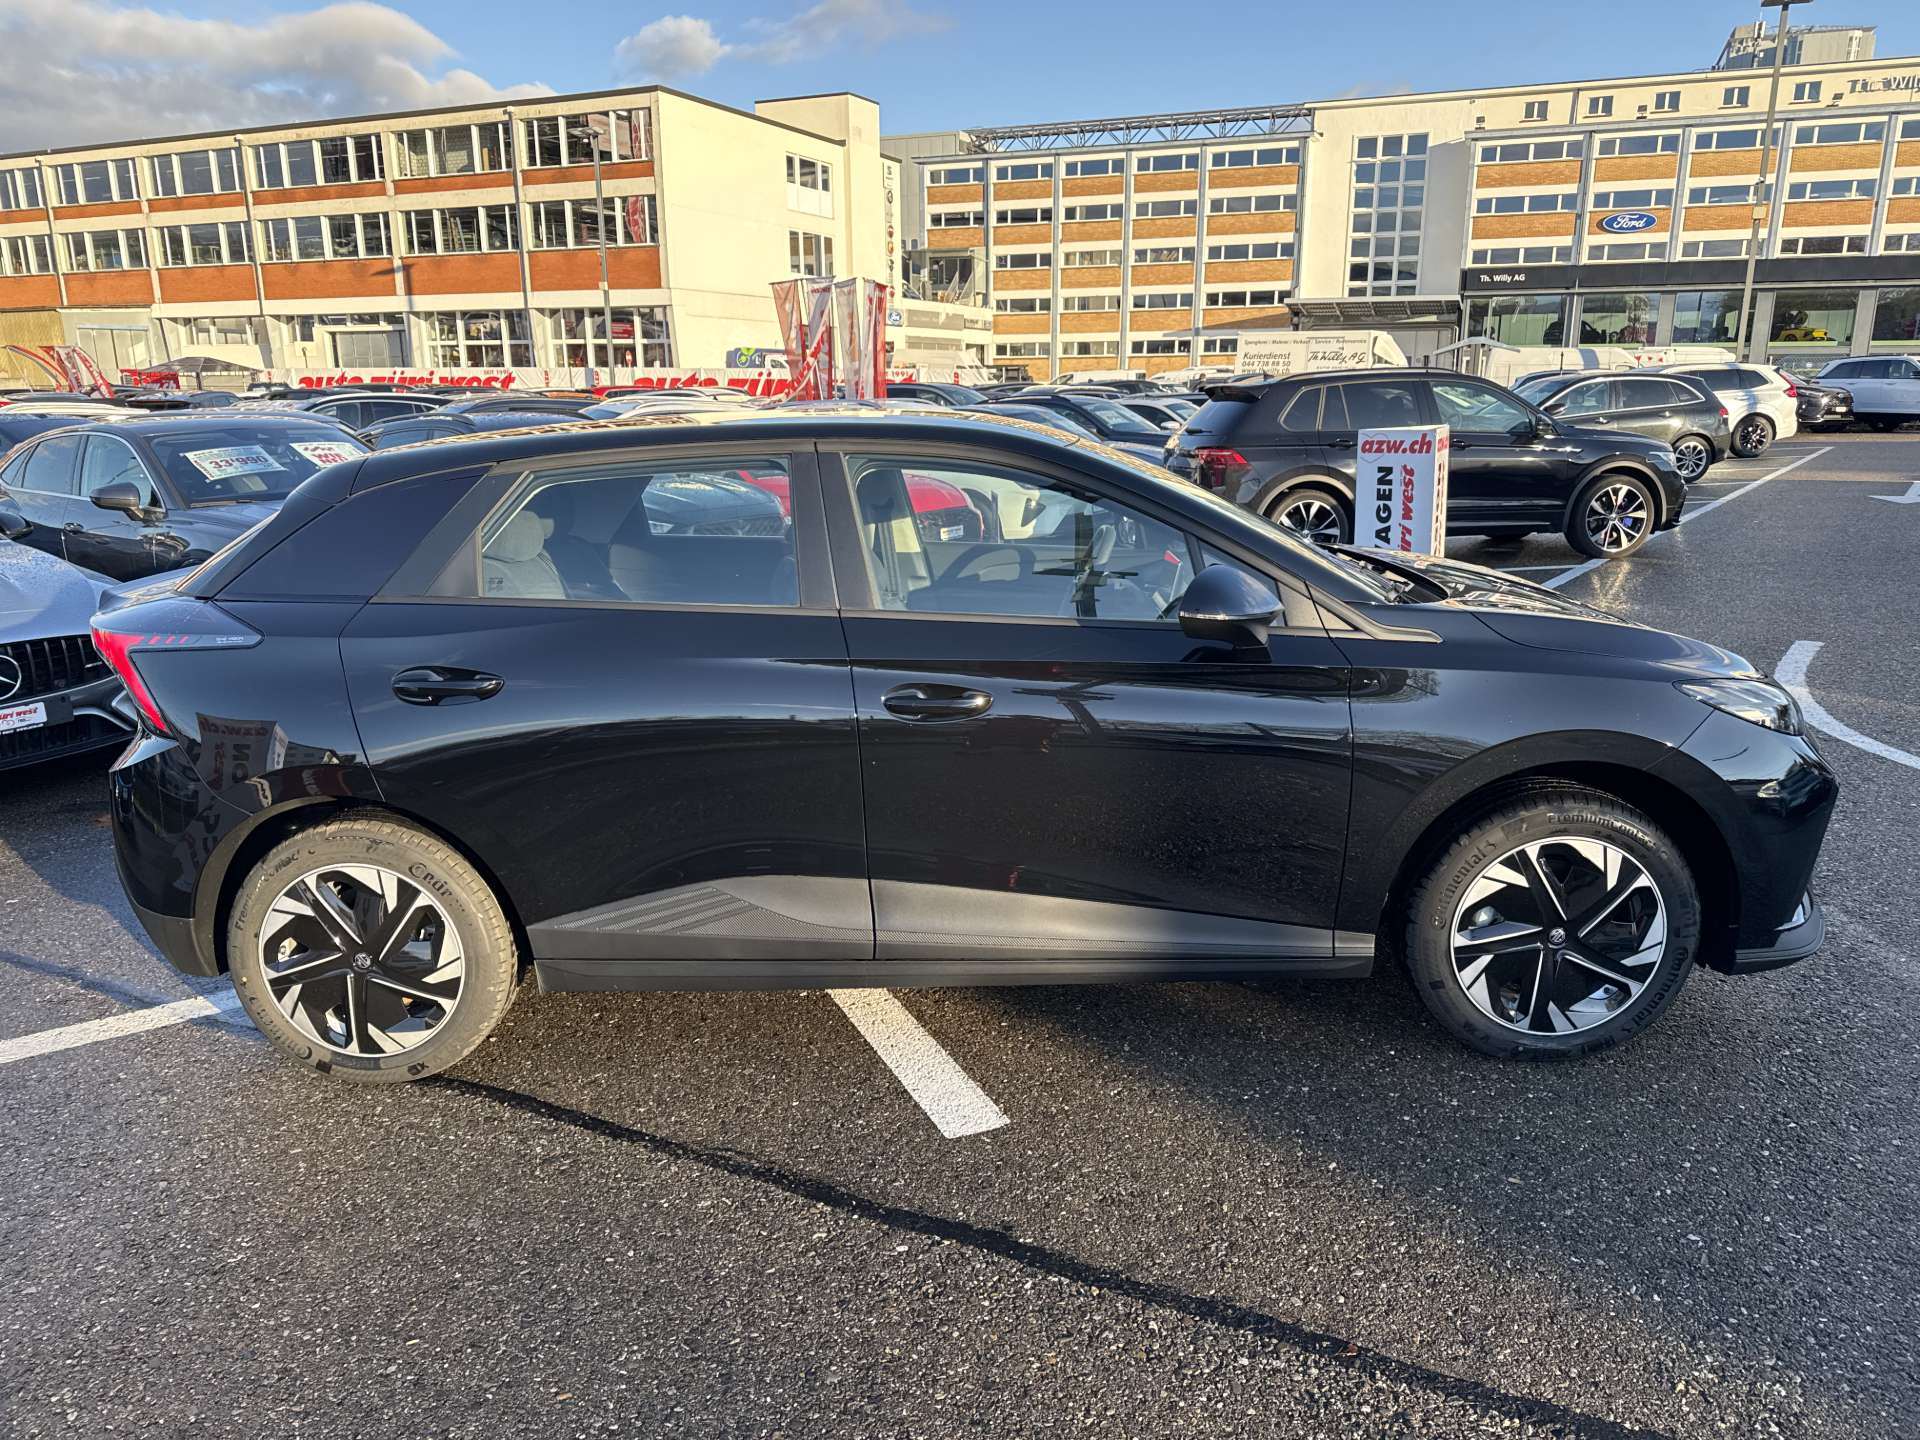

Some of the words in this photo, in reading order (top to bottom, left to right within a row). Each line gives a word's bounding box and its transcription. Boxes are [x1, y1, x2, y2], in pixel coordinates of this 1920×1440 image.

[1612, 214, 1647, 229] Ford
[1493, 274, 1512, 284] Willy
[1514, 273, 1526, 281] AG
[1242, 352, 1291, 360] Kurierdienst
[1320, 350, 1347, 364] Willy
[1349, 351, 1367, 364] AG
[299, 371, 364, 388] auto
[1361, 432, 1433, 454] azw.ch
[1402, 464, 1415, 521] west
[1375, 466, 1394, 548] AGEN
[1398, 523, 1412, 553] üri
